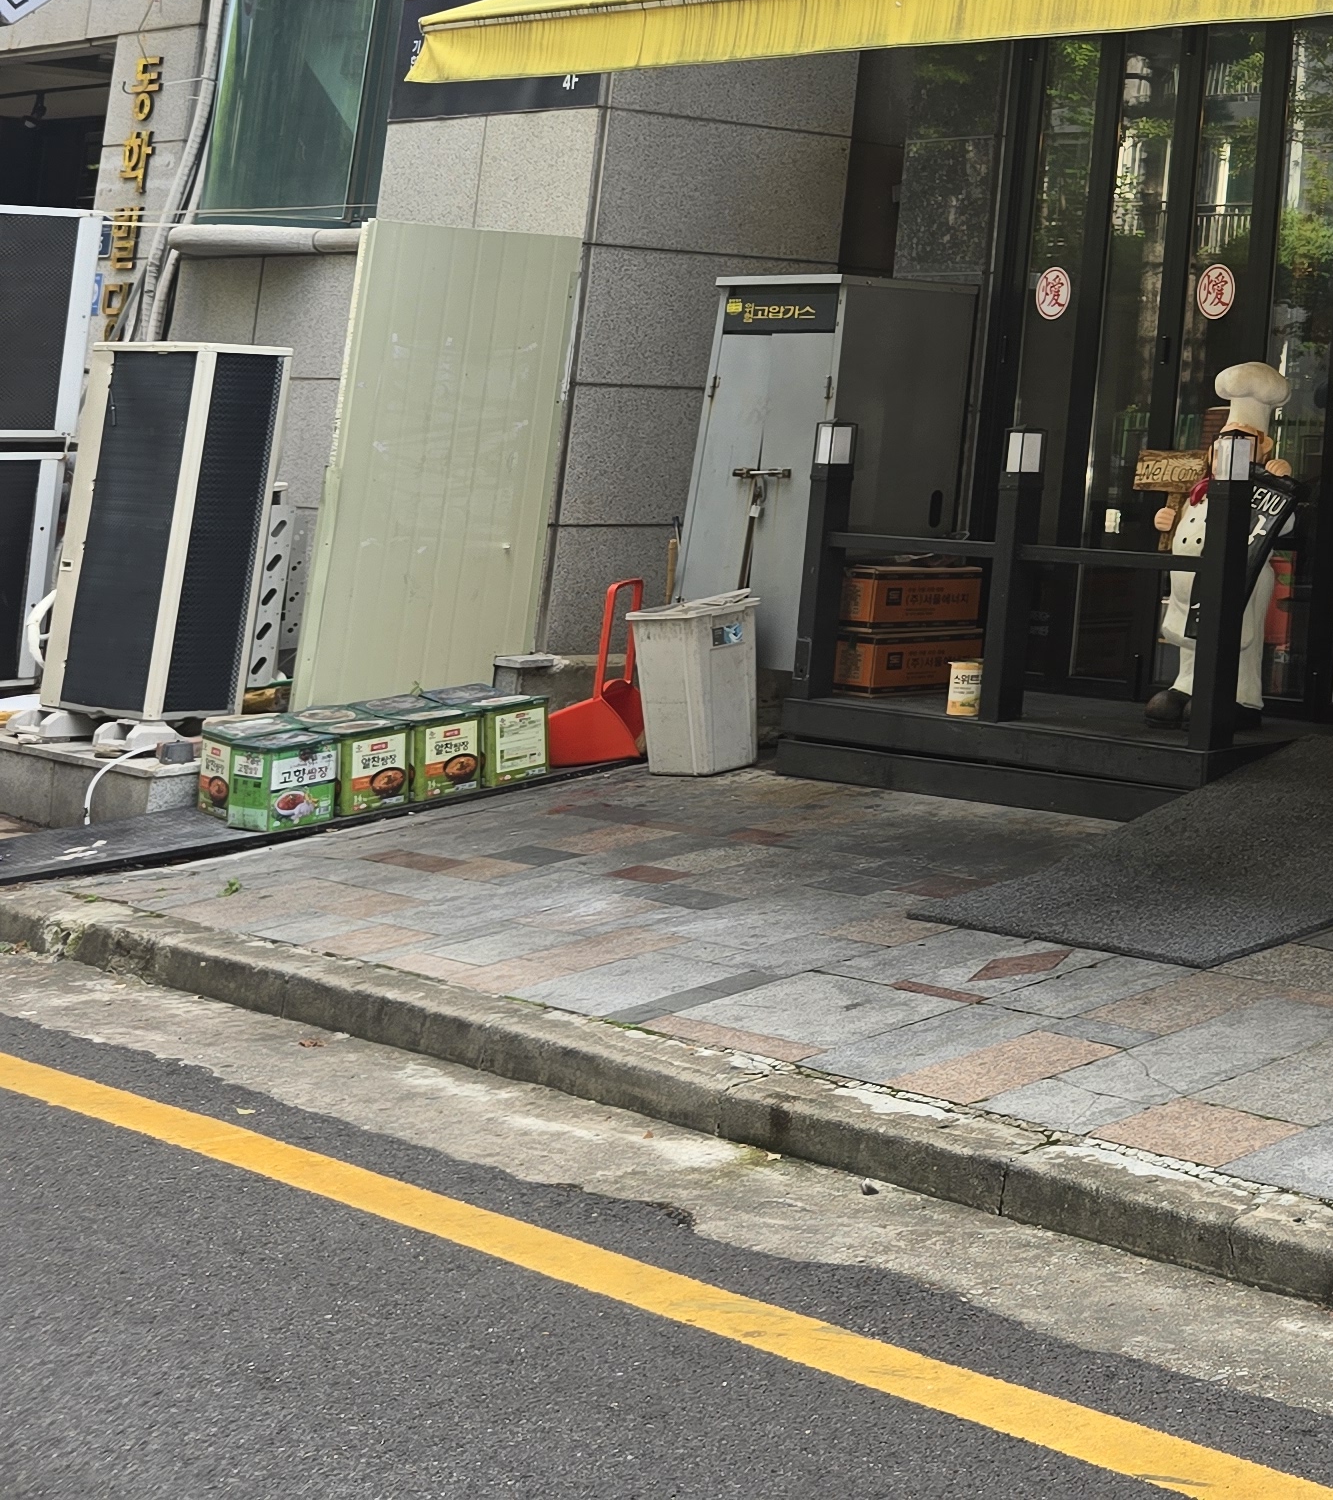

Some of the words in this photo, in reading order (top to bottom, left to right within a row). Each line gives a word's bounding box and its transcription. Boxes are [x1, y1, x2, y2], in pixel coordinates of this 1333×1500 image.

[753, 305, 816, 319] 고압가스
[1252, 485, 1287, 516] ENU
[954, 674, 981, 685] 스위트
[280, 766, 328, 784] 고향쌈장
